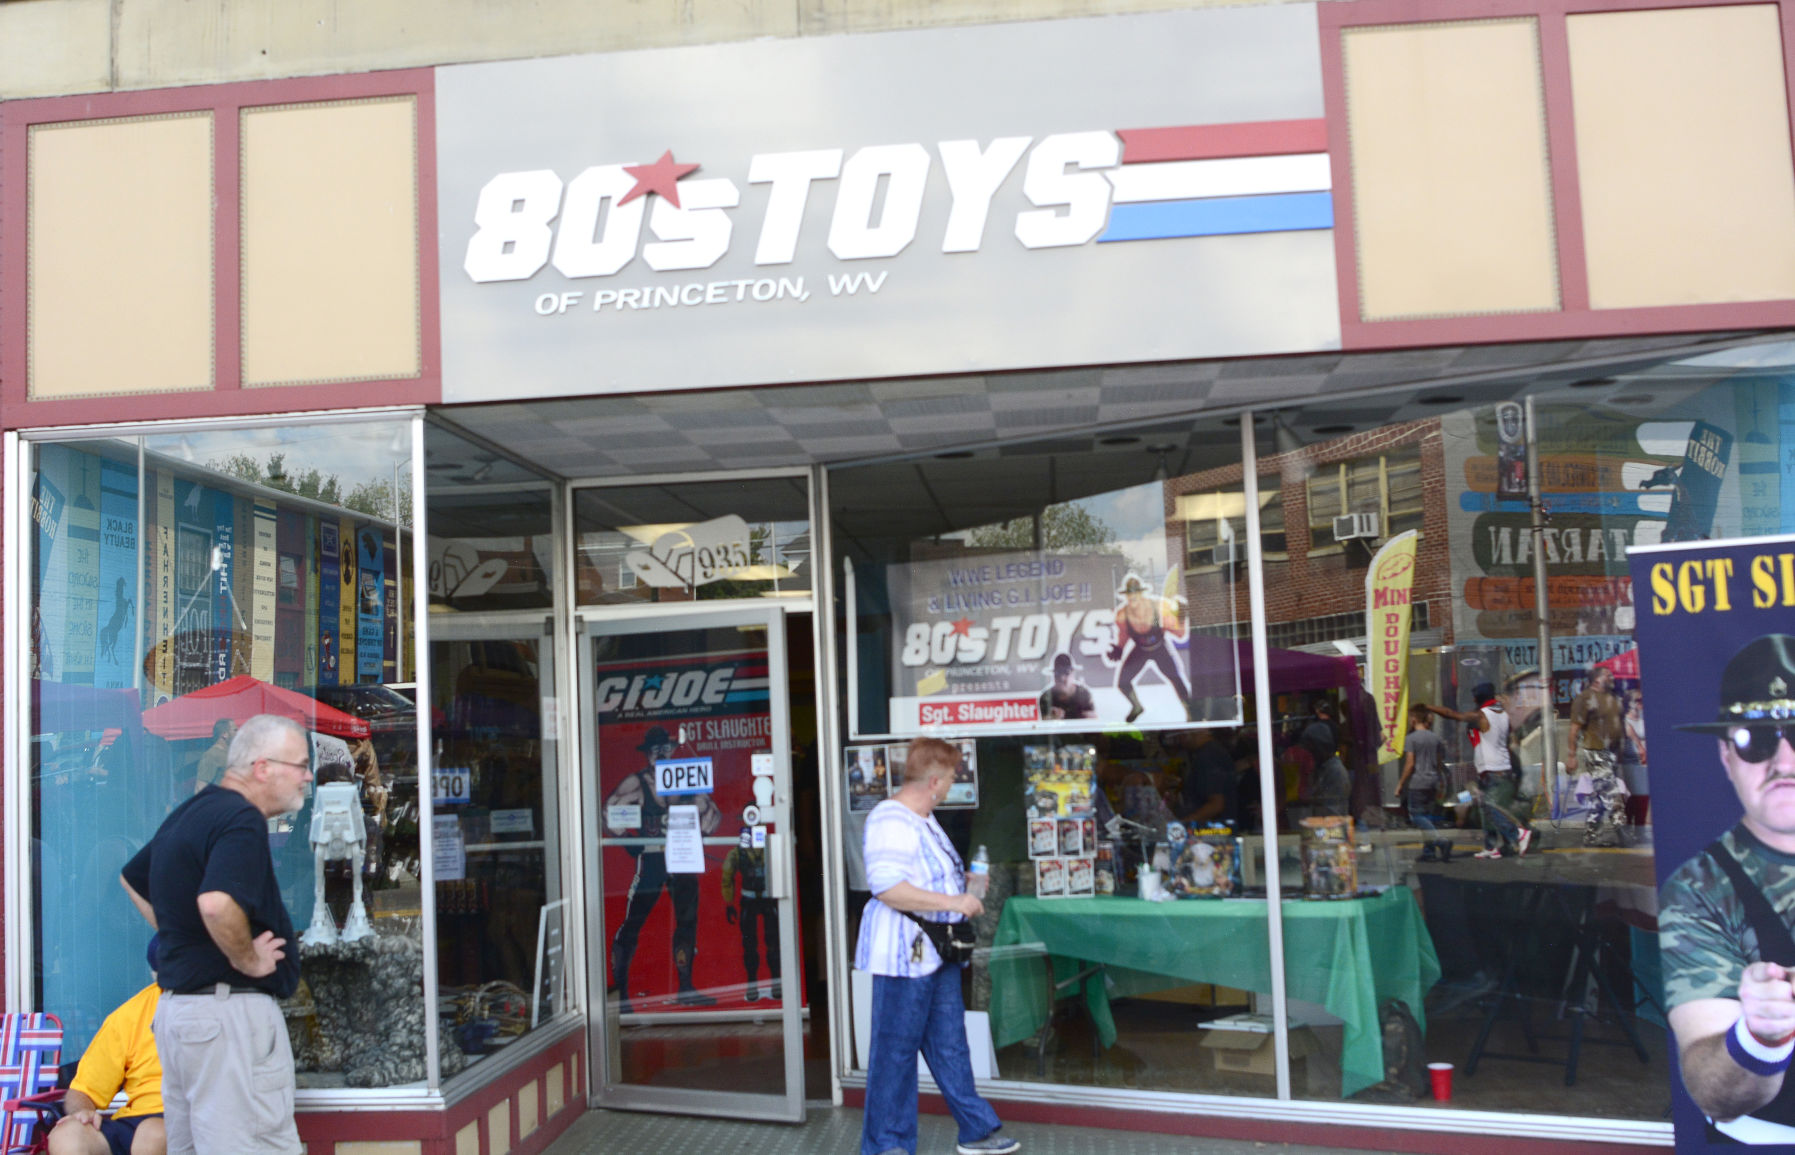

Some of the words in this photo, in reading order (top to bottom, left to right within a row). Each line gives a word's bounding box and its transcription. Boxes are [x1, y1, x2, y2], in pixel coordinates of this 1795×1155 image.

[748, 130, 1119, 266] TOYS
[534, 290, 583, 316] OF
[593, 275, 811, 313] PRINCETON,
[827, 271, 888, 296] WV
[698, 541, 748, 580] 935
[950, 565, 992, 588] WWE
[995, 559, 1065, 582] LEGEND
[944, 589, 1001, 613] LIVING
[1040, 583, 1076, 605] JOE
[1373, 586, 1412, 610] MINI
[1650, 558, 1733, 616] SGT
[991, 609, 1117, 663] TOYS
[921, 705, 954, 725] Sgt.
[958, 701, 1036, 724] Slaughter
[678, 721, 703, 742] SGT
[706, 716, 772, 741] SLAUGHTE
[662, 764, 709, 789] OPEN
